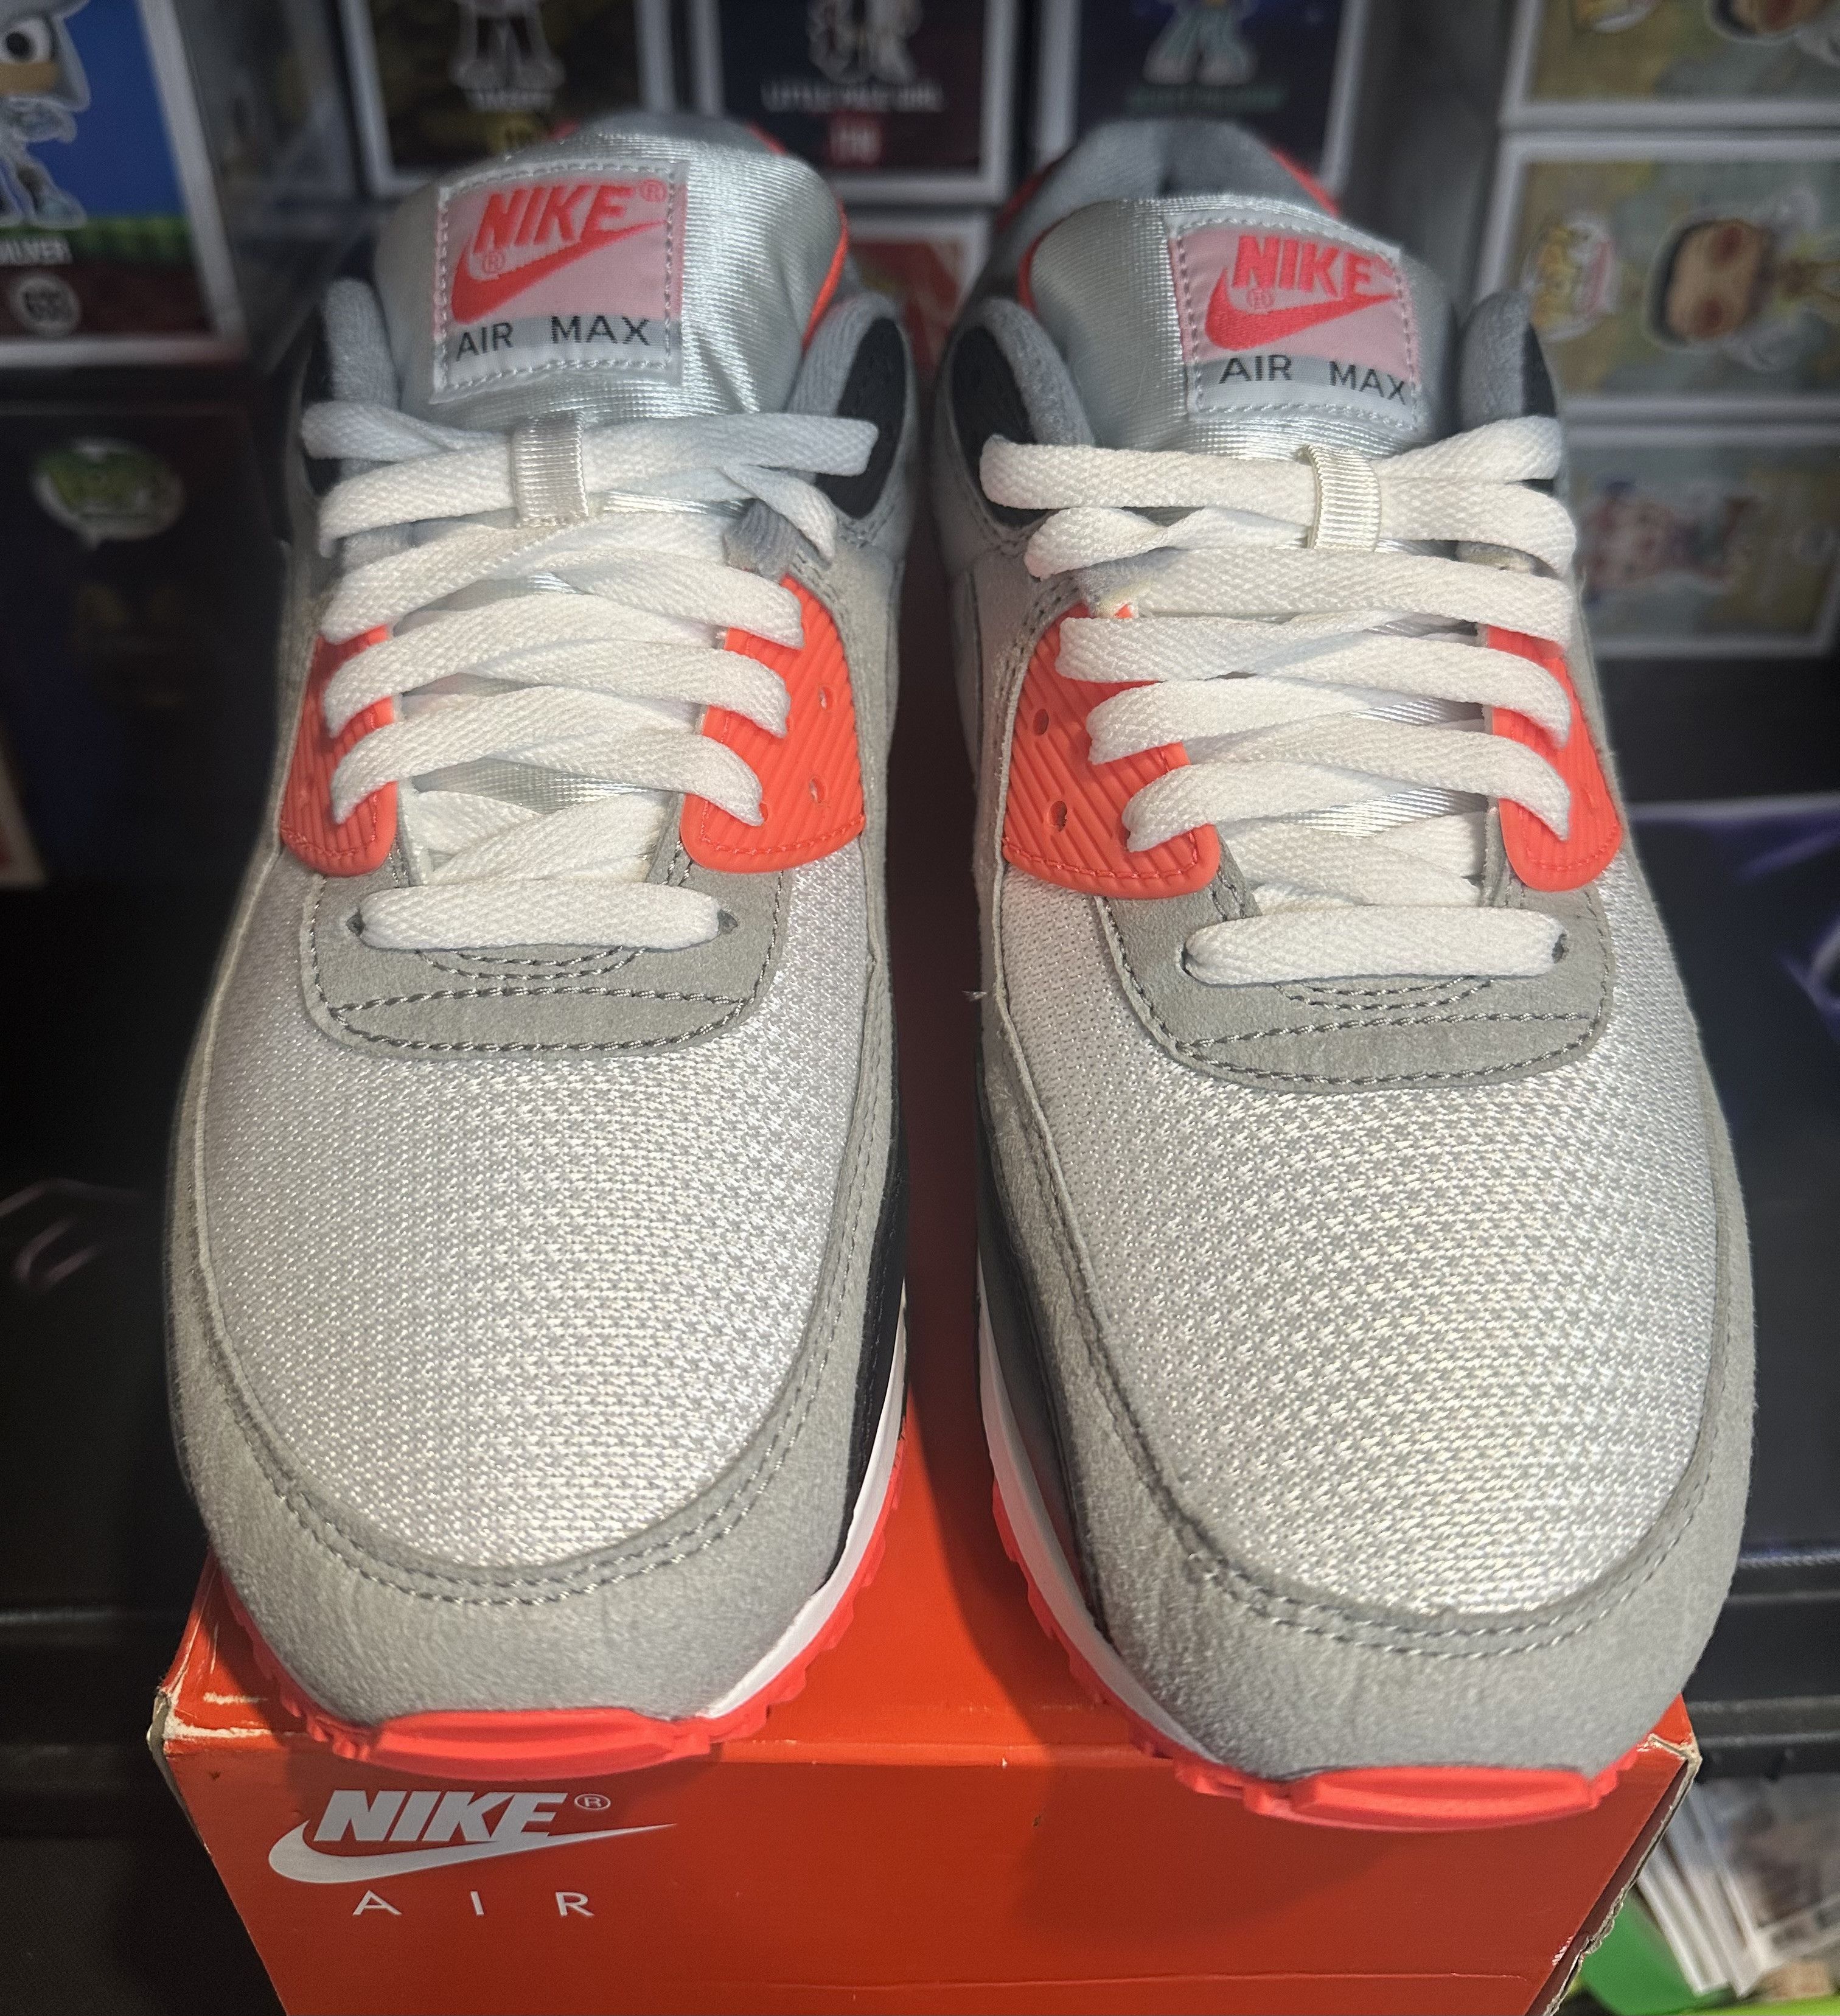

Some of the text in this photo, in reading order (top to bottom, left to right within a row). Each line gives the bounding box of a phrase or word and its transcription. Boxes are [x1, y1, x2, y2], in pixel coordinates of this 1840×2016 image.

[456, 315, 651, 362] AIR MAX
[1219, 354, 1407, 405] AIR MAX
[352, 1889, 595, 1917] AIR
